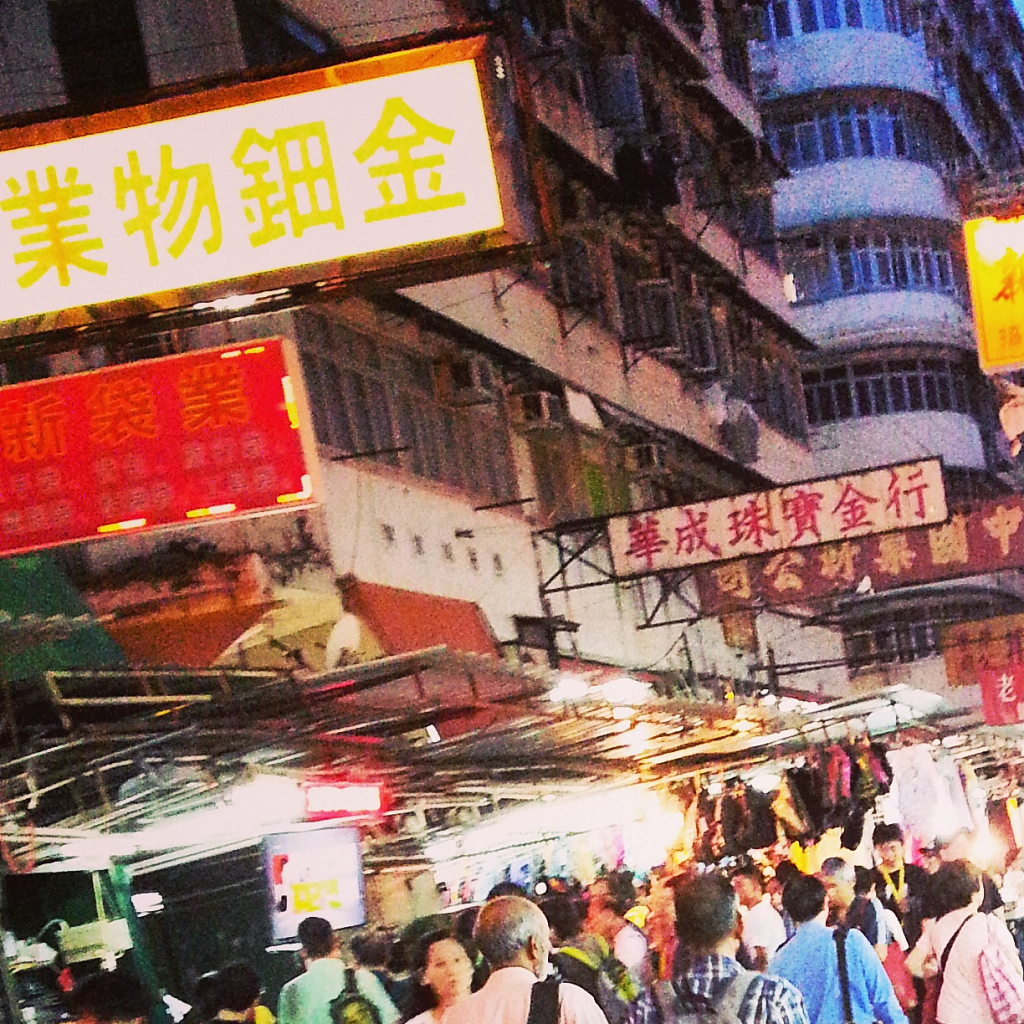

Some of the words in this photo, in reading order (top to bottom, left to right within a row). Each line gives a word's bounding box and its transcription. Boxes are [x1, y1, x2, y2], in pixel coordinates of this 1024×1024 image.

[625, 467, 929, 568] 華成珠寶金行
